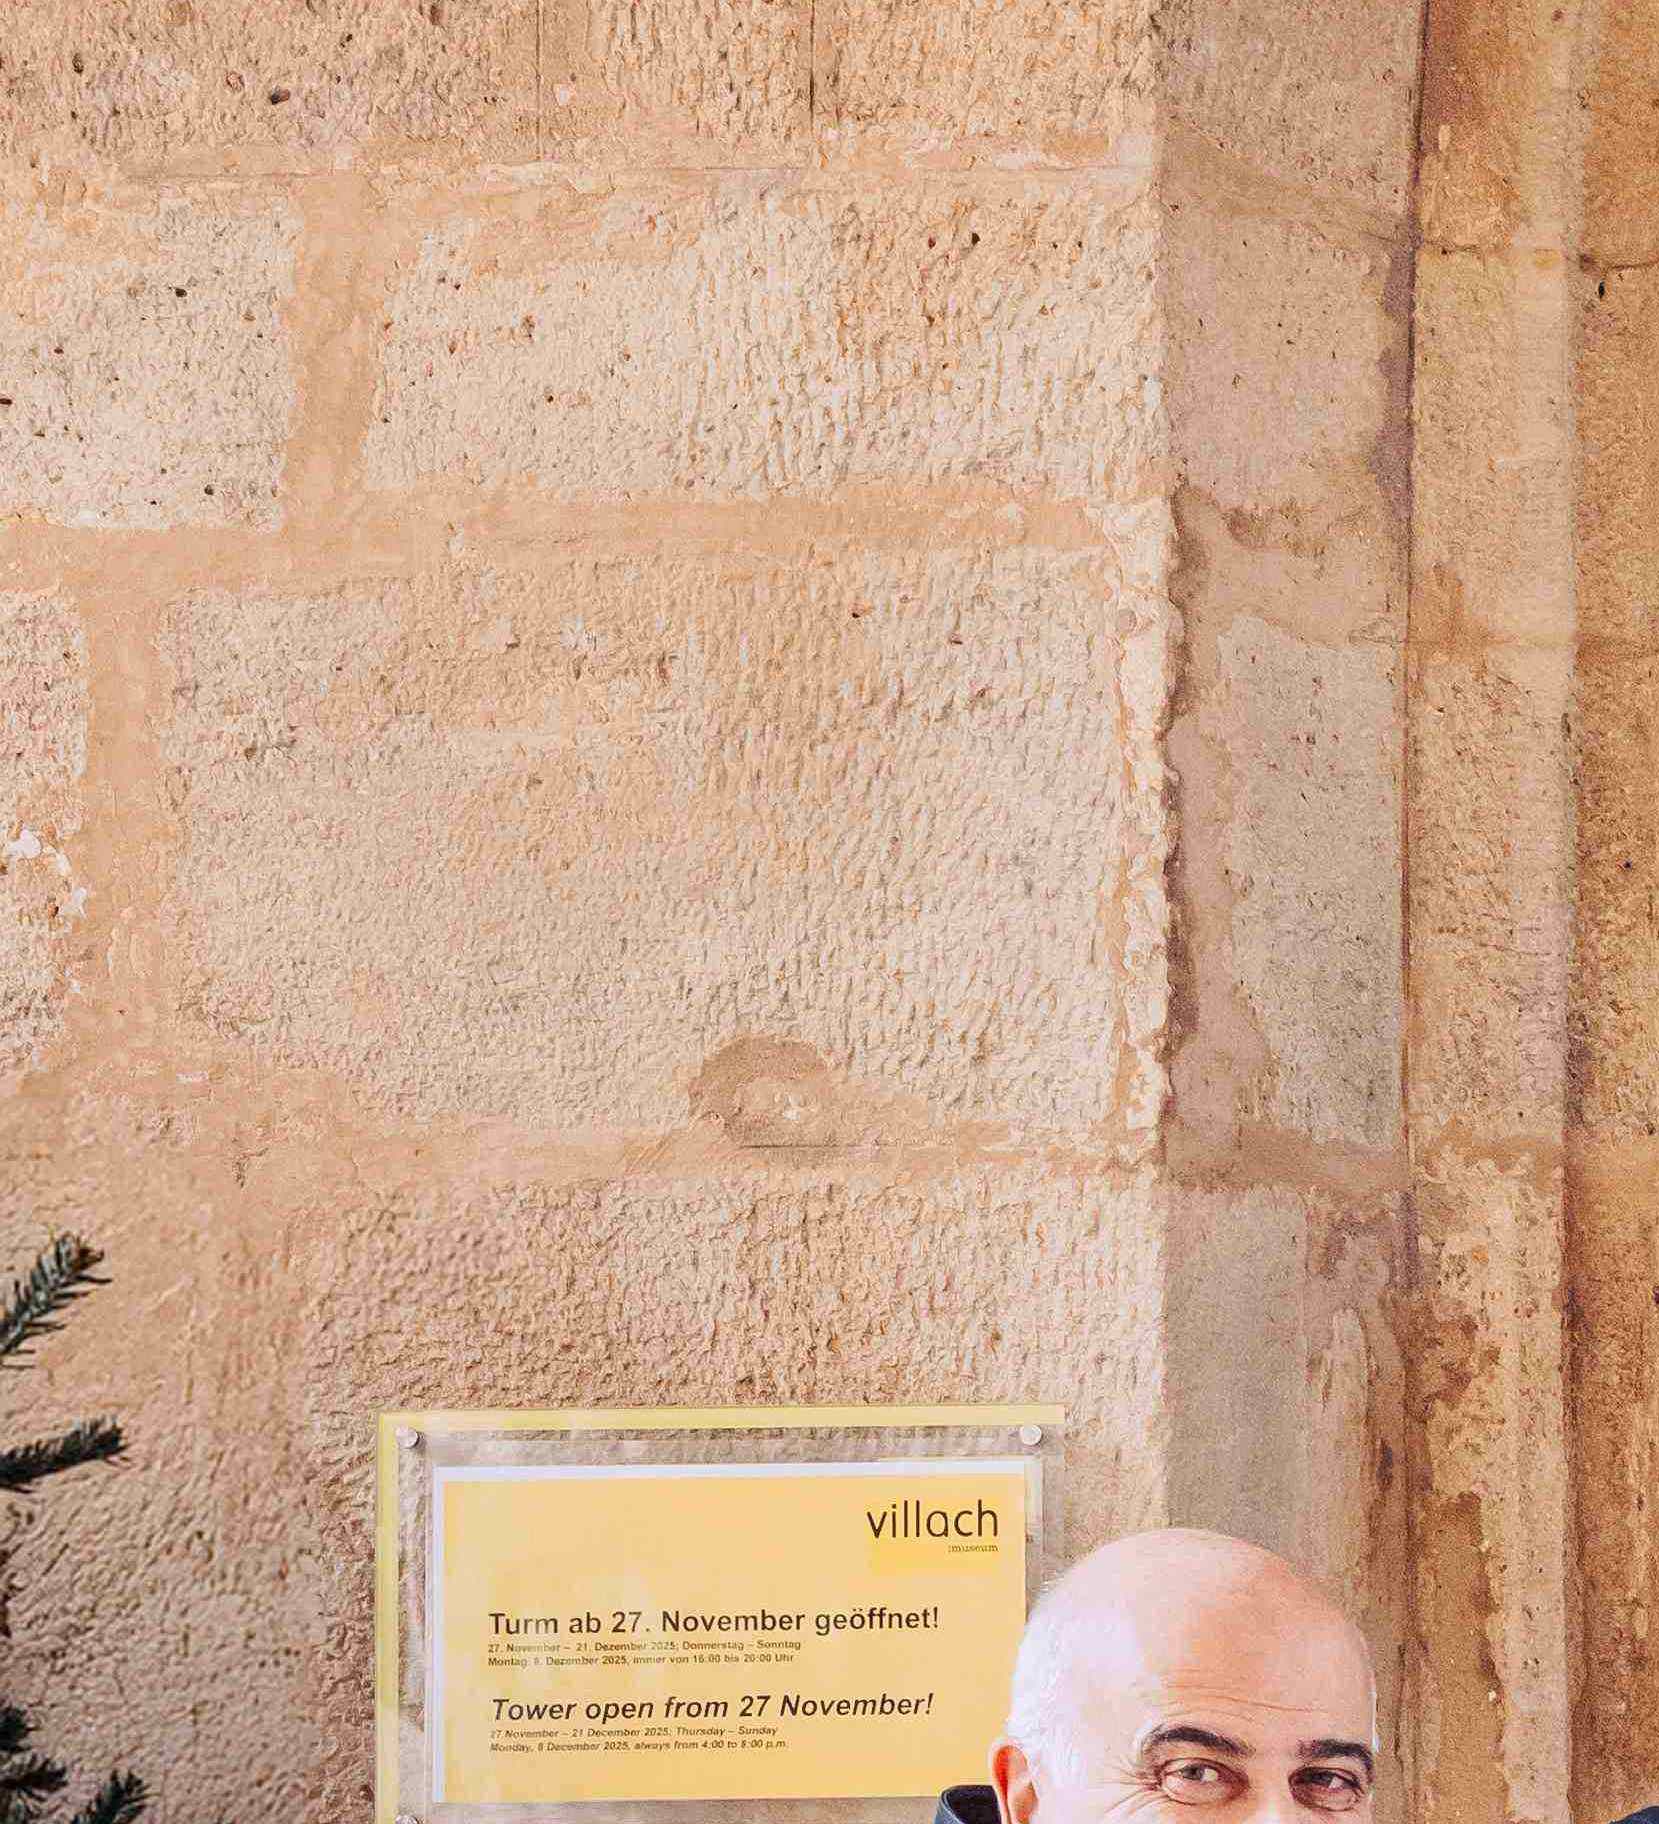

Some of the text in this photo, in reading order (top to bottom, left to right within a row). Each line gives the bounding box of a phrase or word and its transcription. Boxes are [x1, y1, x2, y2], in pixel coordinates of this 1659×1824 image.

[866, 1498, 999, 1539] villach
[488, 1606, 939, 1637] Turm ab 27. November geöffnet!
[506, 1642, 560, 1653] November
[594, 1641, 648, 1652] Dezember
[682, 1640, 745, 1651] Donnerstag
[756, 1639, 801, 1651] Sonntag
[546, 1655, 599, 1666] Dezember
[670, 1655, 690, 1664] von
[724, 1654, 739, 1663] bis
[775, 1653, 794, 1663] Uhr
[492, 1692, 934, 1725] Tower open from 27 November!
[504, 1729, 560, 1739] November
[587, 1727, 641, 1737] December
[676, 1726, 726, 1738] Thursday
[737, 1725, 779, 1737] Sunday
[546, 1742, 600, 1752] December
[634, 1741, 671, 1752] always
[674, 1740, 698, 1750] from
[727, 1740, 738, 1750] to
